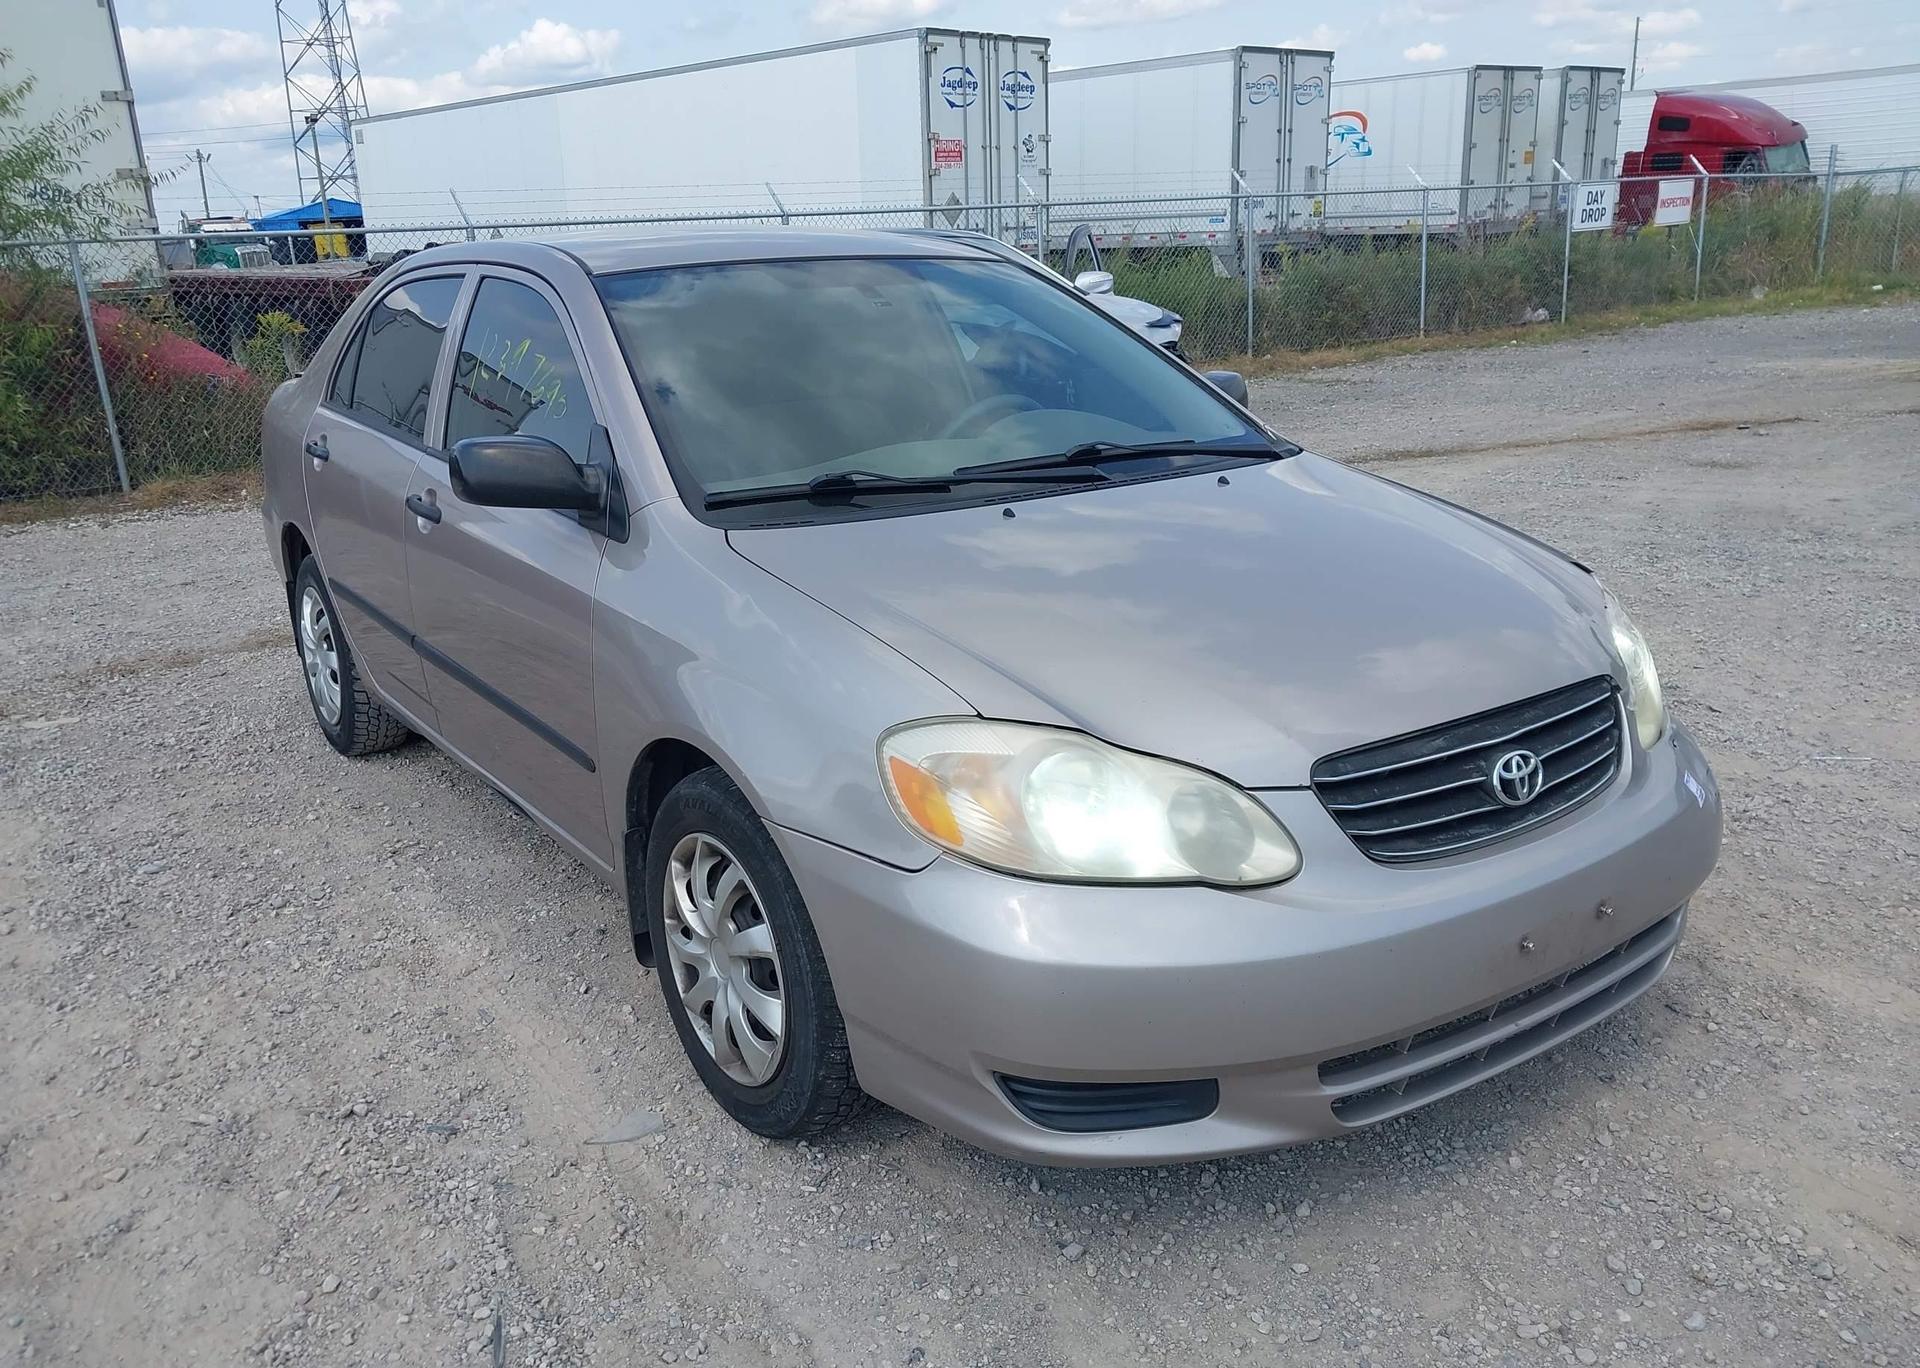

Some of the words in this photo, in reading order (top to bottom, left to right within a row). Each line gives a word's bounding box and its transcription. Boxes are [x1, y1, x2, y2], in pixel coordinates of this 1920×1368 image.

[1000, 80, 1035, 95] Jagdeep
[1245, 82, 1267, 90] SPOT
[1292, 83, 1313, 91] SPOT
[1586, 189, 1606, 206] DAY
[1659, 196, 1691, 209] INSPECTION
[1580, 207, 1607, 224] DROP
